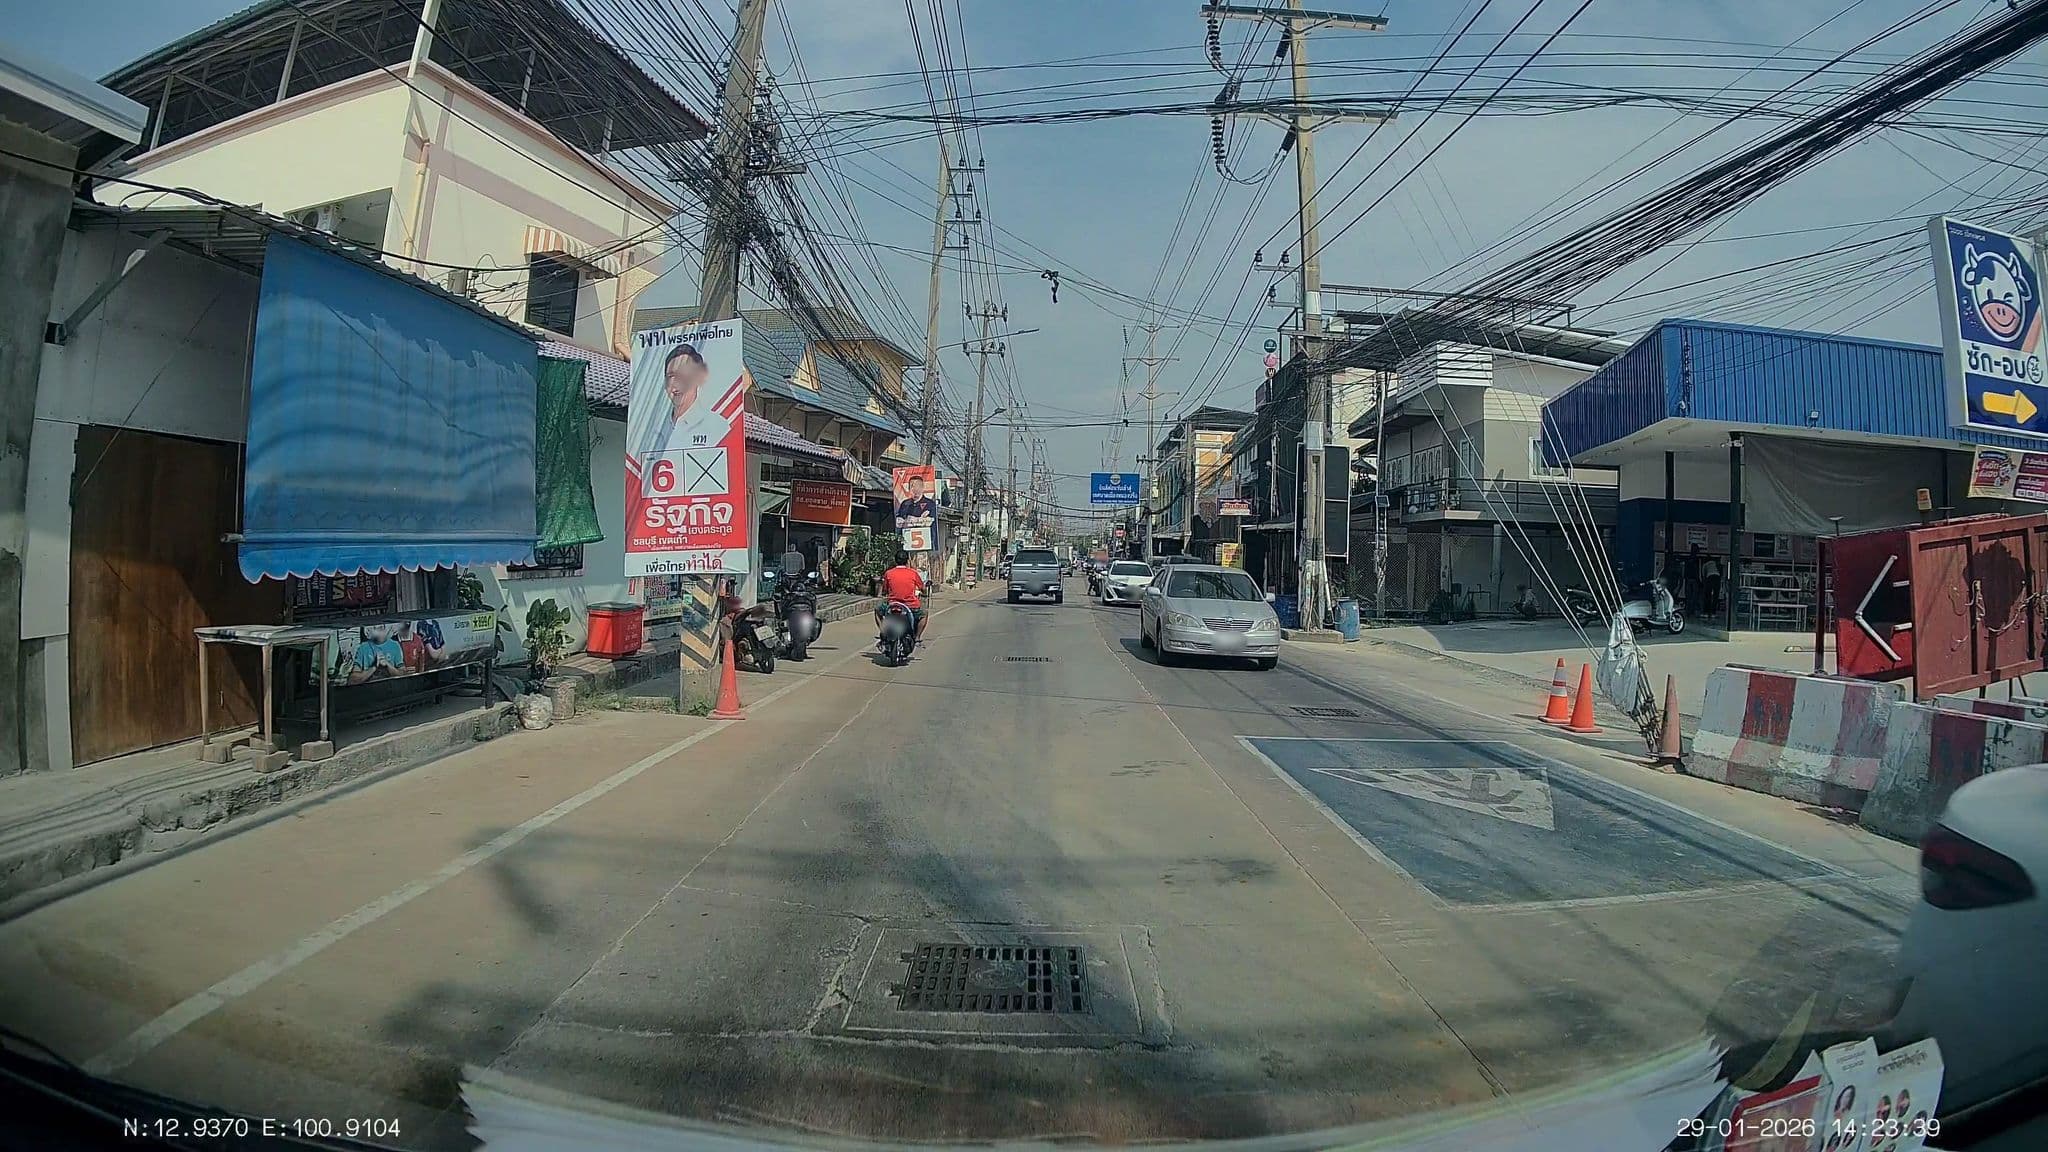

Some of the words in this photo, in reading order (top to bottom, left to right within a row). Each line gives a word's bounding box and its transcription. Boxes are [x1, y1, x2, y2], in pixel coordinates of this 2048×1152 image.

[668, 326, 733, 344] พรรคเพื่อไทย
[1966, 343, 2026, 379] ซัก-อบ
[652, 459, 675, 493] 6
[645, 497, 733, 534] รัฐกิจ
[633, 535, 657, 548] ชลบุรี
[659, 534, 688, 545] เขตเก้า
[911, 531, 924, 549] 5
